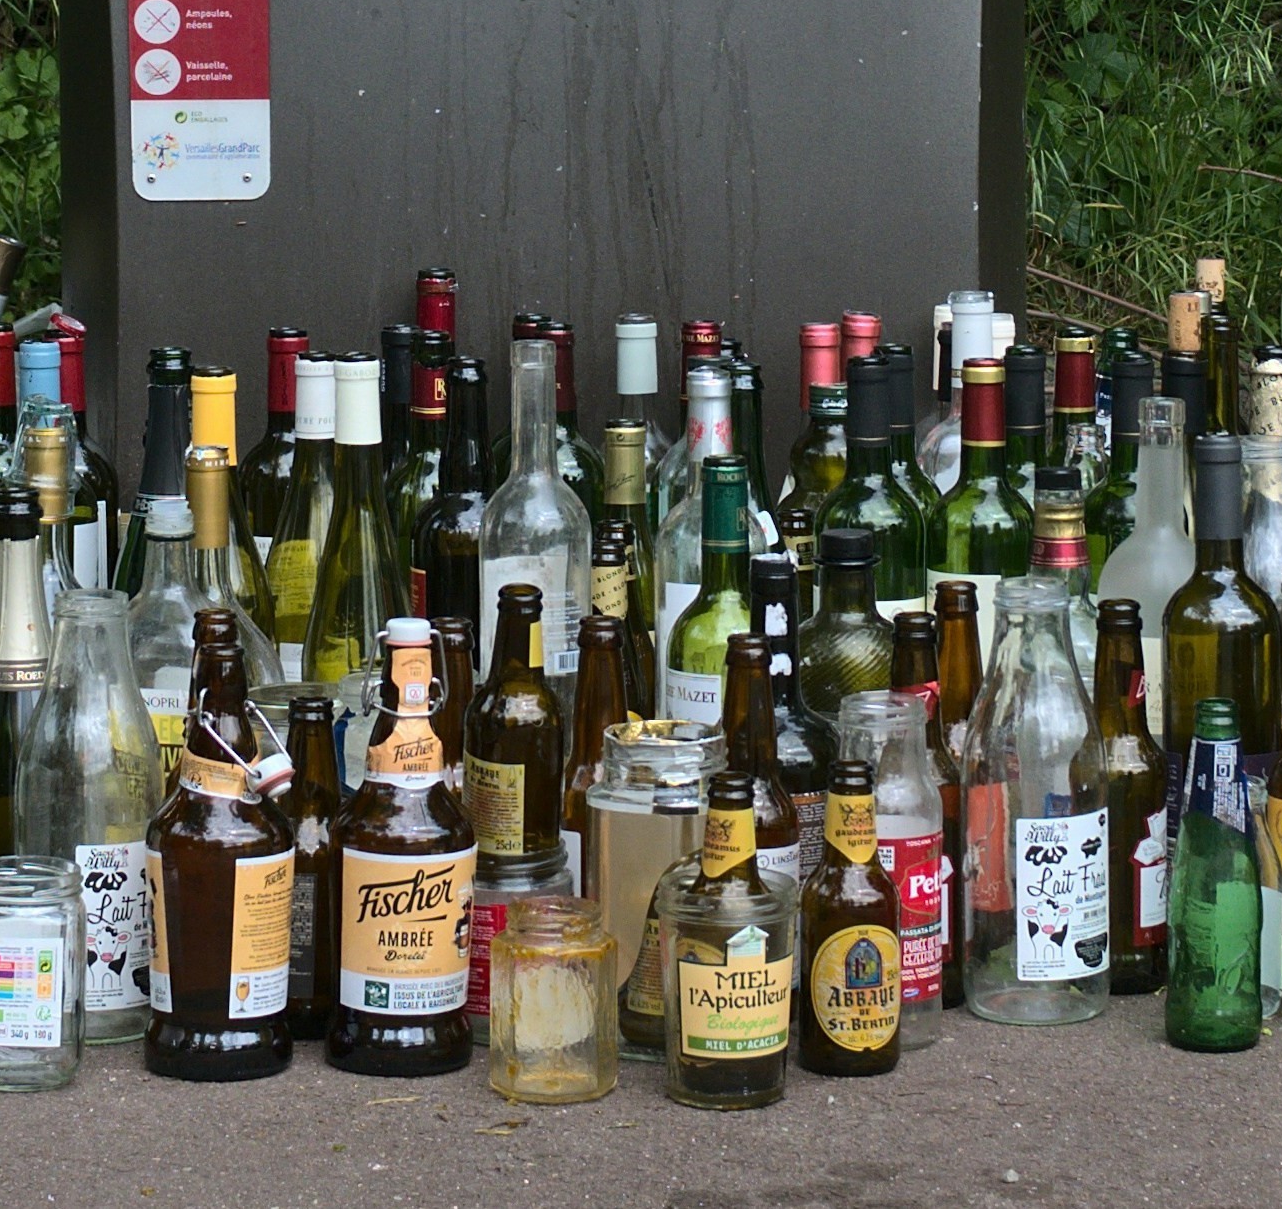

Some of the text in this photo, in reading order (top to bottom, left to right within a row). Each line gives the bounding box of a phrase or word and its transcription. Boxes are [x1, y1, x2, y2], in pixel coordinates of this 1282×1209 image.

[185, 9, 233, 20] Ampoules,
[185, 20, 213, 29] néons
[185, 60, 229, 70] Vaisselle,
[185, 71, 233, 83] porcelaine
[677, 685, 717, 704] MAZET
[393, 736, 435, 764] Fischer
[1026, 866, 1078, 899] Lait
[356, 864, 456, 923] Fischer
[86, 892, 134, 927] Lait
[378, 928, 434, 948] AMBRÉE
[714, 971, 777, 990] MIEL
[416, 989, 426, 1000] DE
[688, 983, 791, 1013] l'Apiculteur
[827, 984, 896, 1008] ABBAYE
[393, 1000, 420, 1010] LOCALE
[859, 1006, 870, 1016] DE
[706, 1013, 780, 1035] Biologique
[705, 1034, 780, 1052] MIEL D'ACACIA
